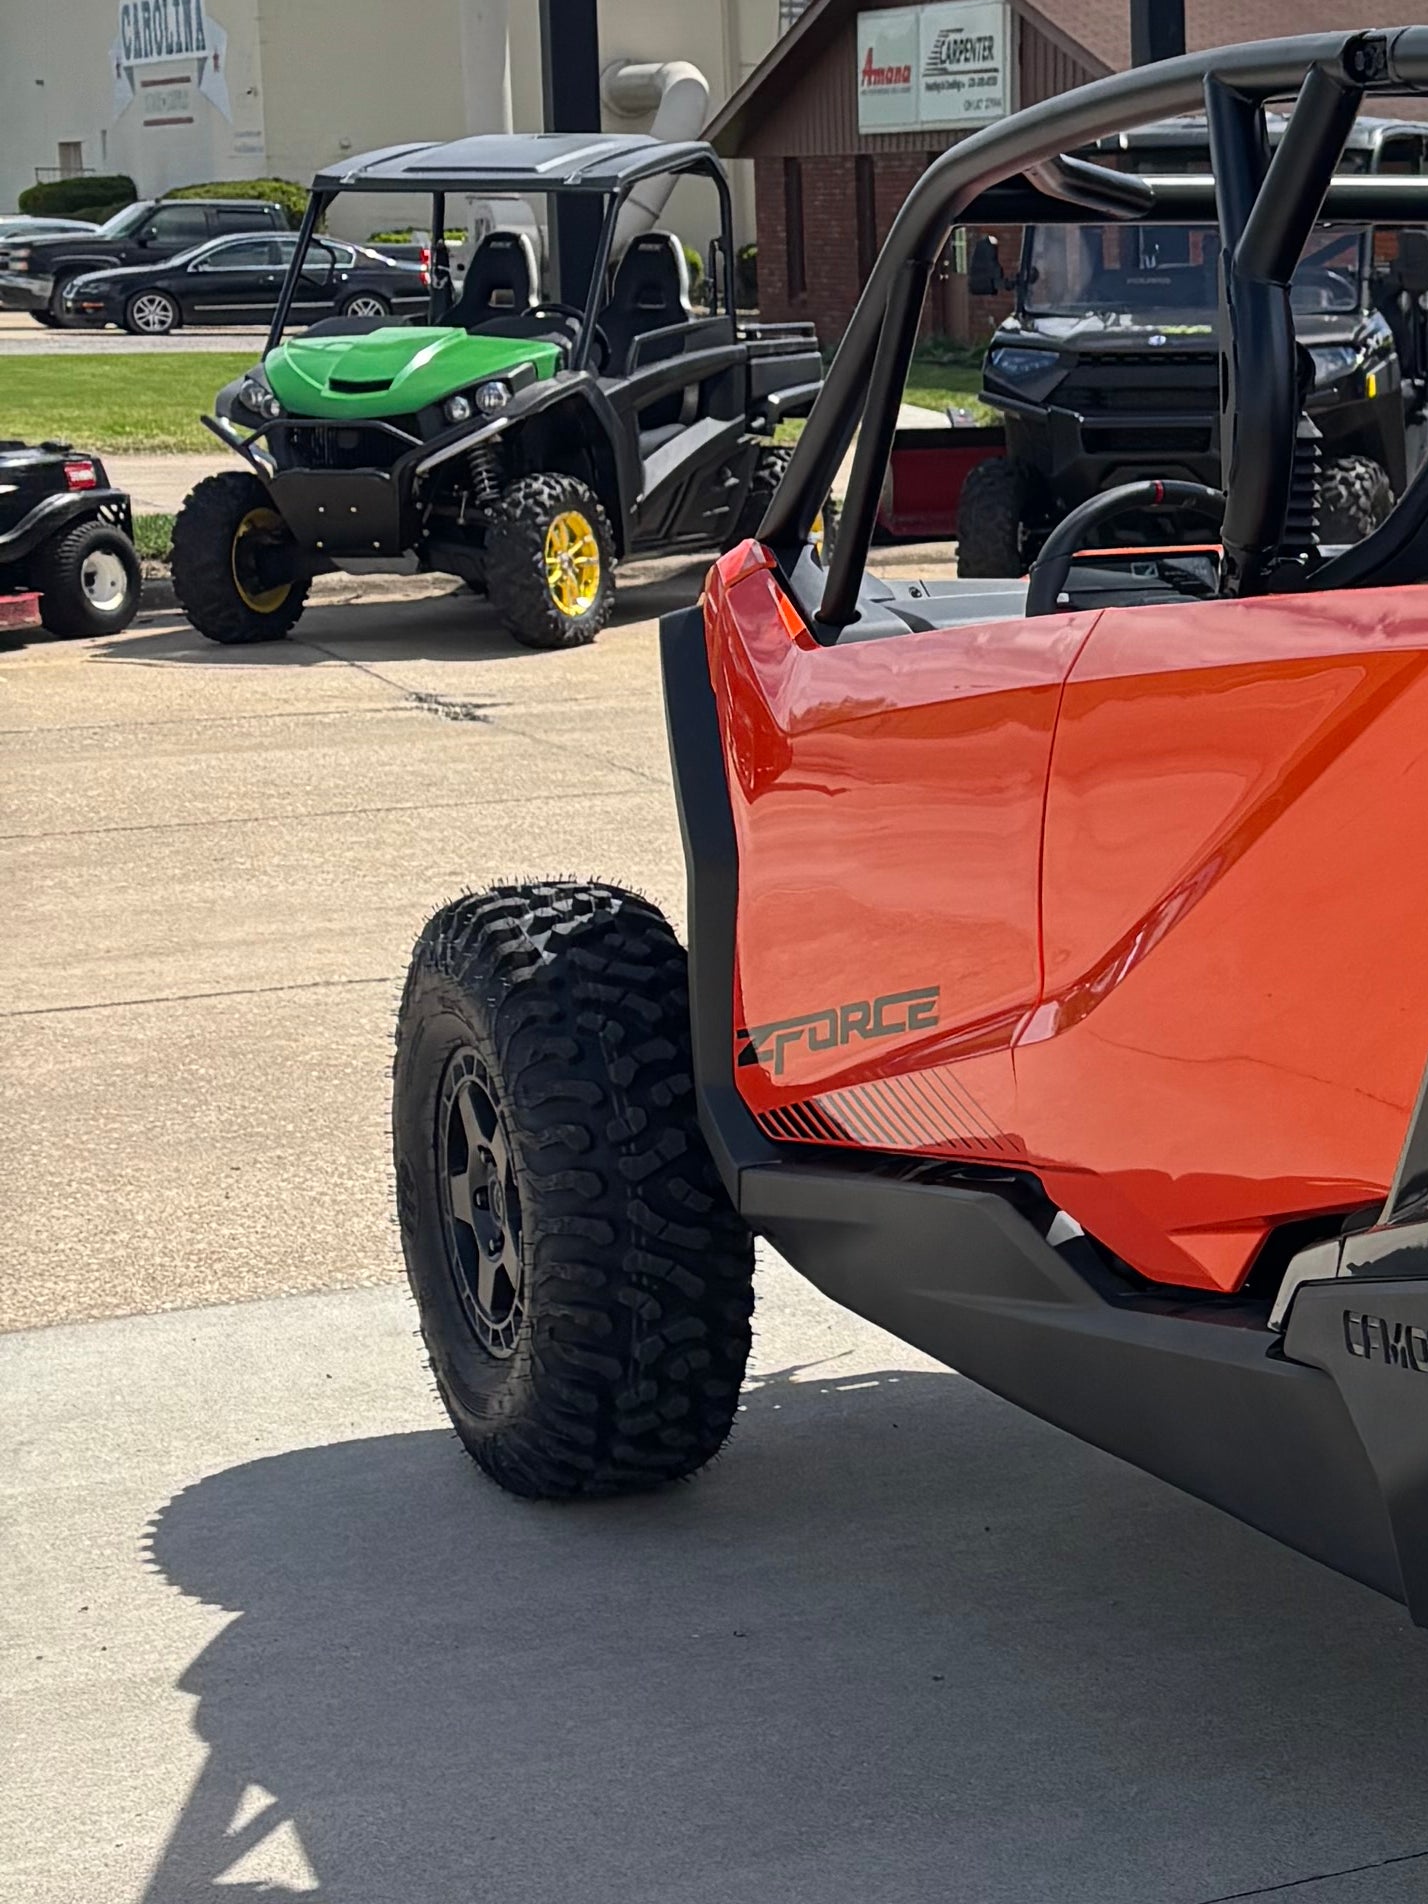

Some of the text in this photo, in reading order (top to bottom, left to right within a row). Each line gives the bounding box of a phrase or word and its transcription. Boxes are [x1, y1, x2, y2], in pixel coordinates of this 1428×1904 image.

[861, 47, 911, 87] Amana
[939, 35, 995, 66] CARPENTER
[736, 985, 940, 1075] ZFORCE
